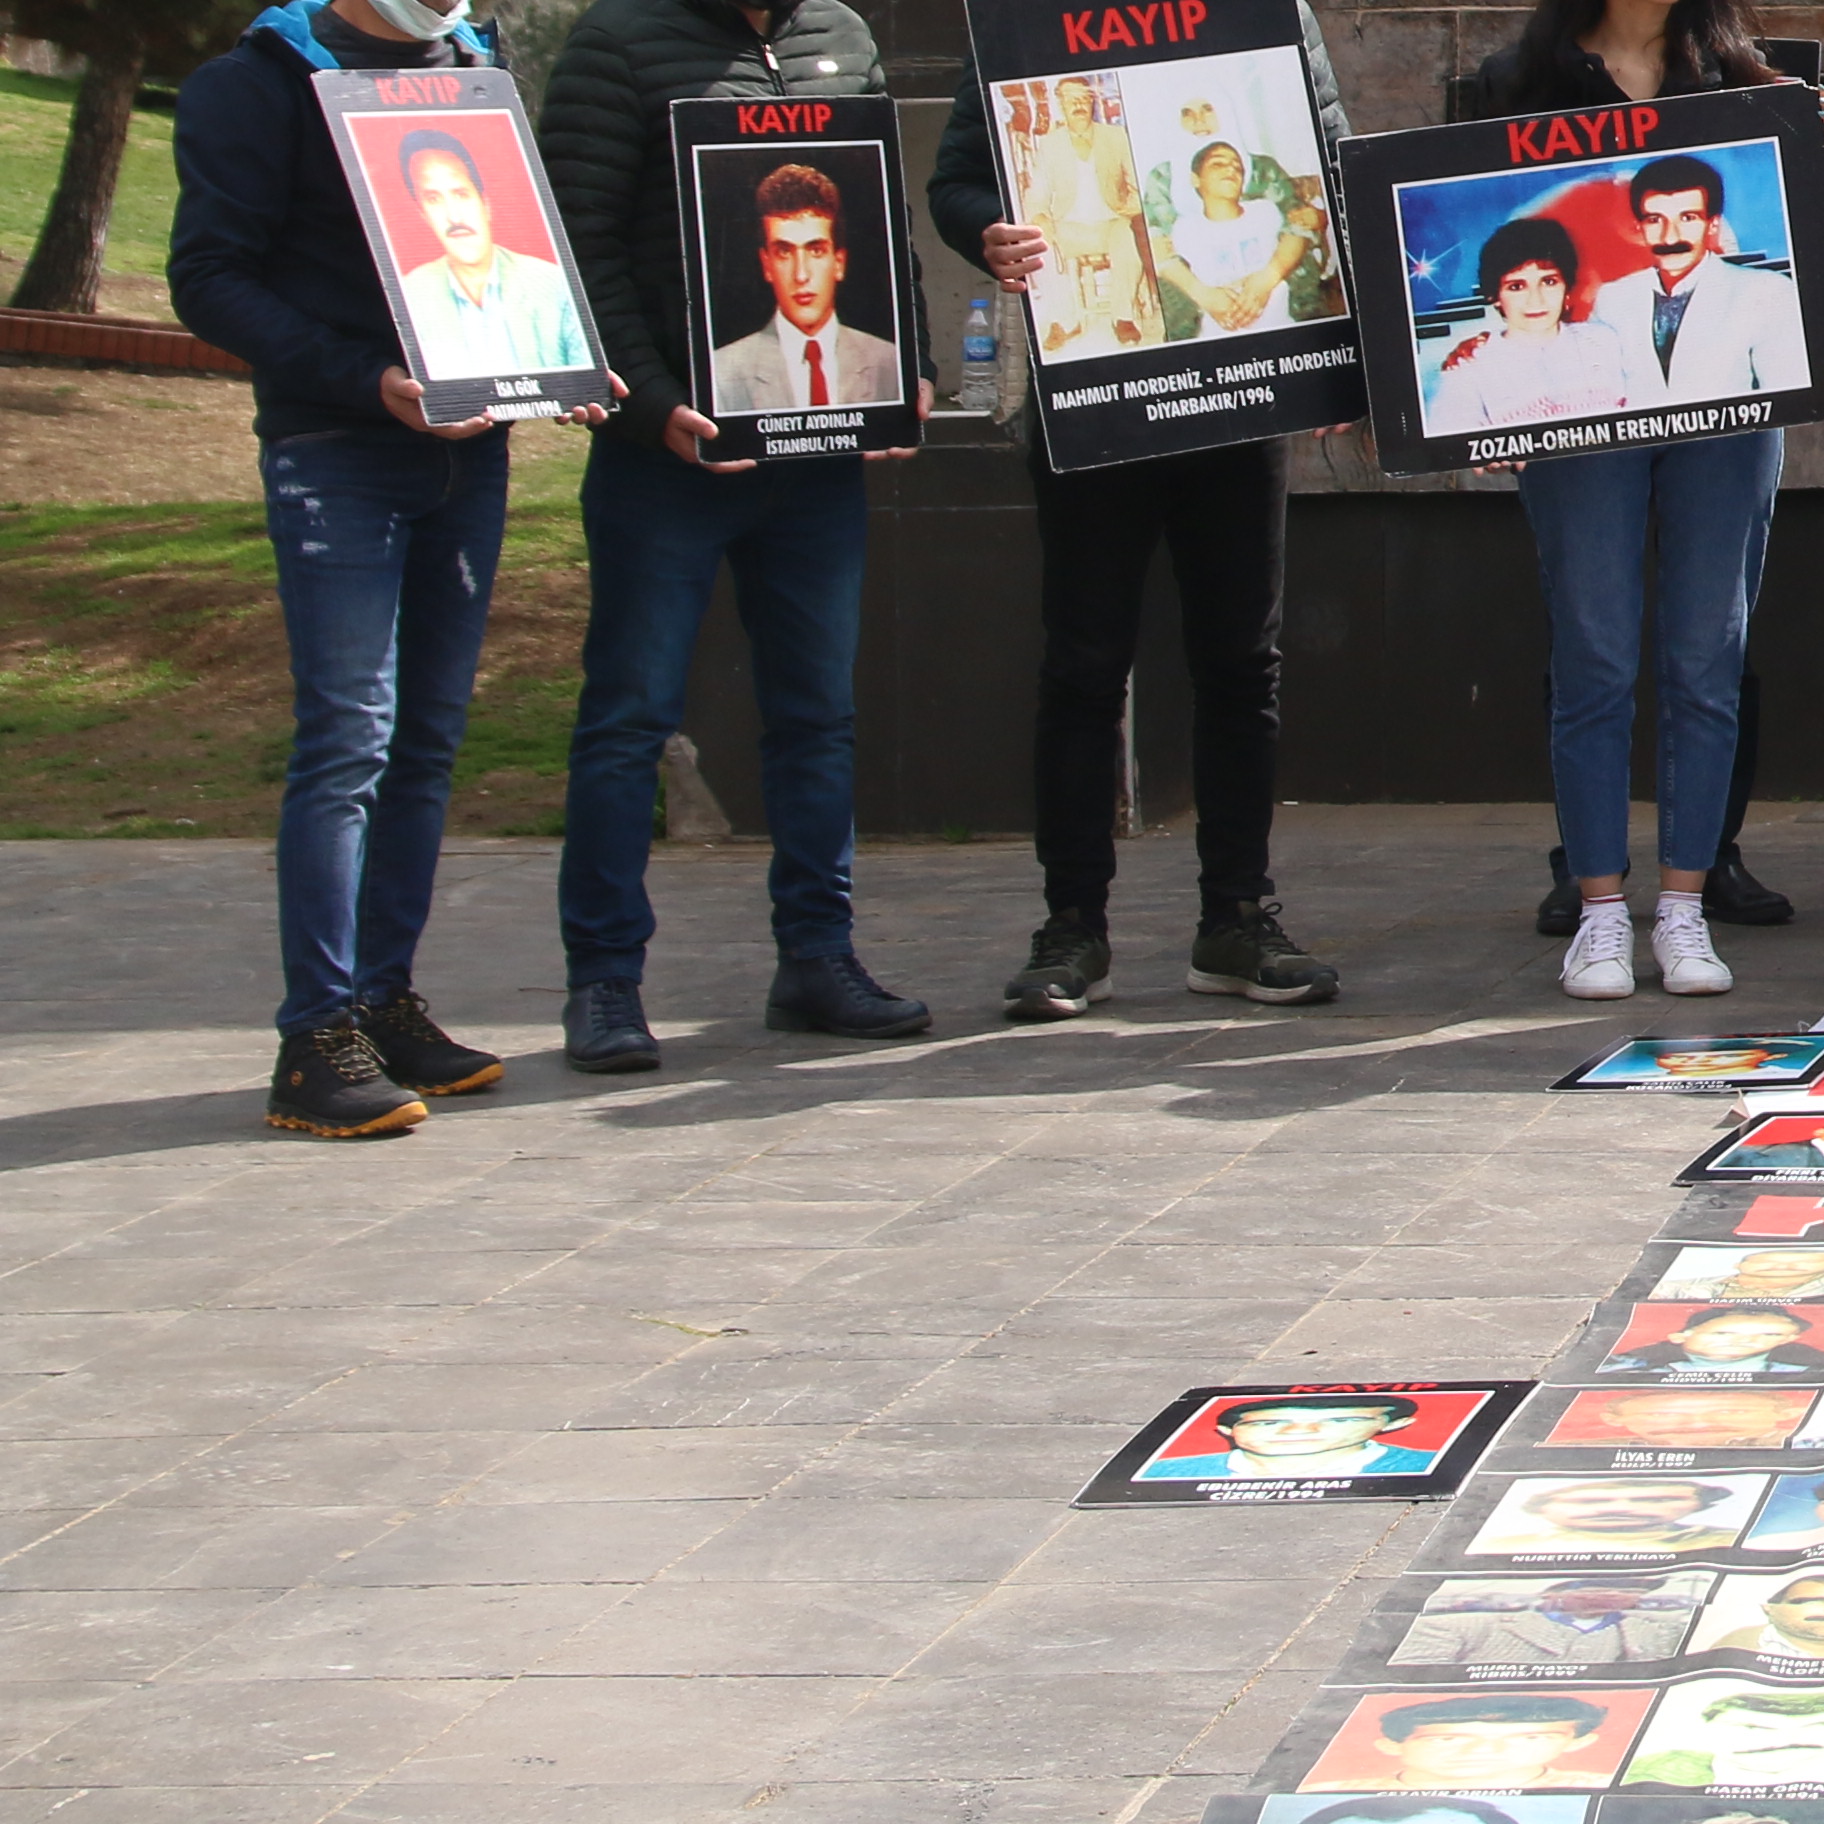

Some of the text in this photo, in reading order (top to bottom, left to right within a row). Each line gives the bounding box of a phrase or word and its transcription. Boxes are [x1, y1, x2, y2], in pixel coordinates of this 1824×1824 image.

[375, 74, 463, 105] KAYIP
[737, 103, 834, 135] KAYIP
[1506, 106, 1660, 164] KAYIP
[493, 376, 543, 398] İSA GÖK
[1051, 382, 1120, 411] MAHMUT
[1122, 367, 1204, 399] MORDENİZ
[1215, 356, 1277, 386] FAHRİYE
[1278, 342, 1358, 376] MORDENİZ
[1145, 384, 1275, 422] DİYARBAKIR/1996
[756, 411, 865, 434] CÜNEYT AYDINLAR
[1466, 400, 1774, 462] ZOZAN-ORHAN EREN/KULP/1997
[765, 434, 859, 456] İSTANBUL/1994
[1288, 1382, 1440, 1394] KAYIP
[1299, 1478, 1354, 1491] ARAS
